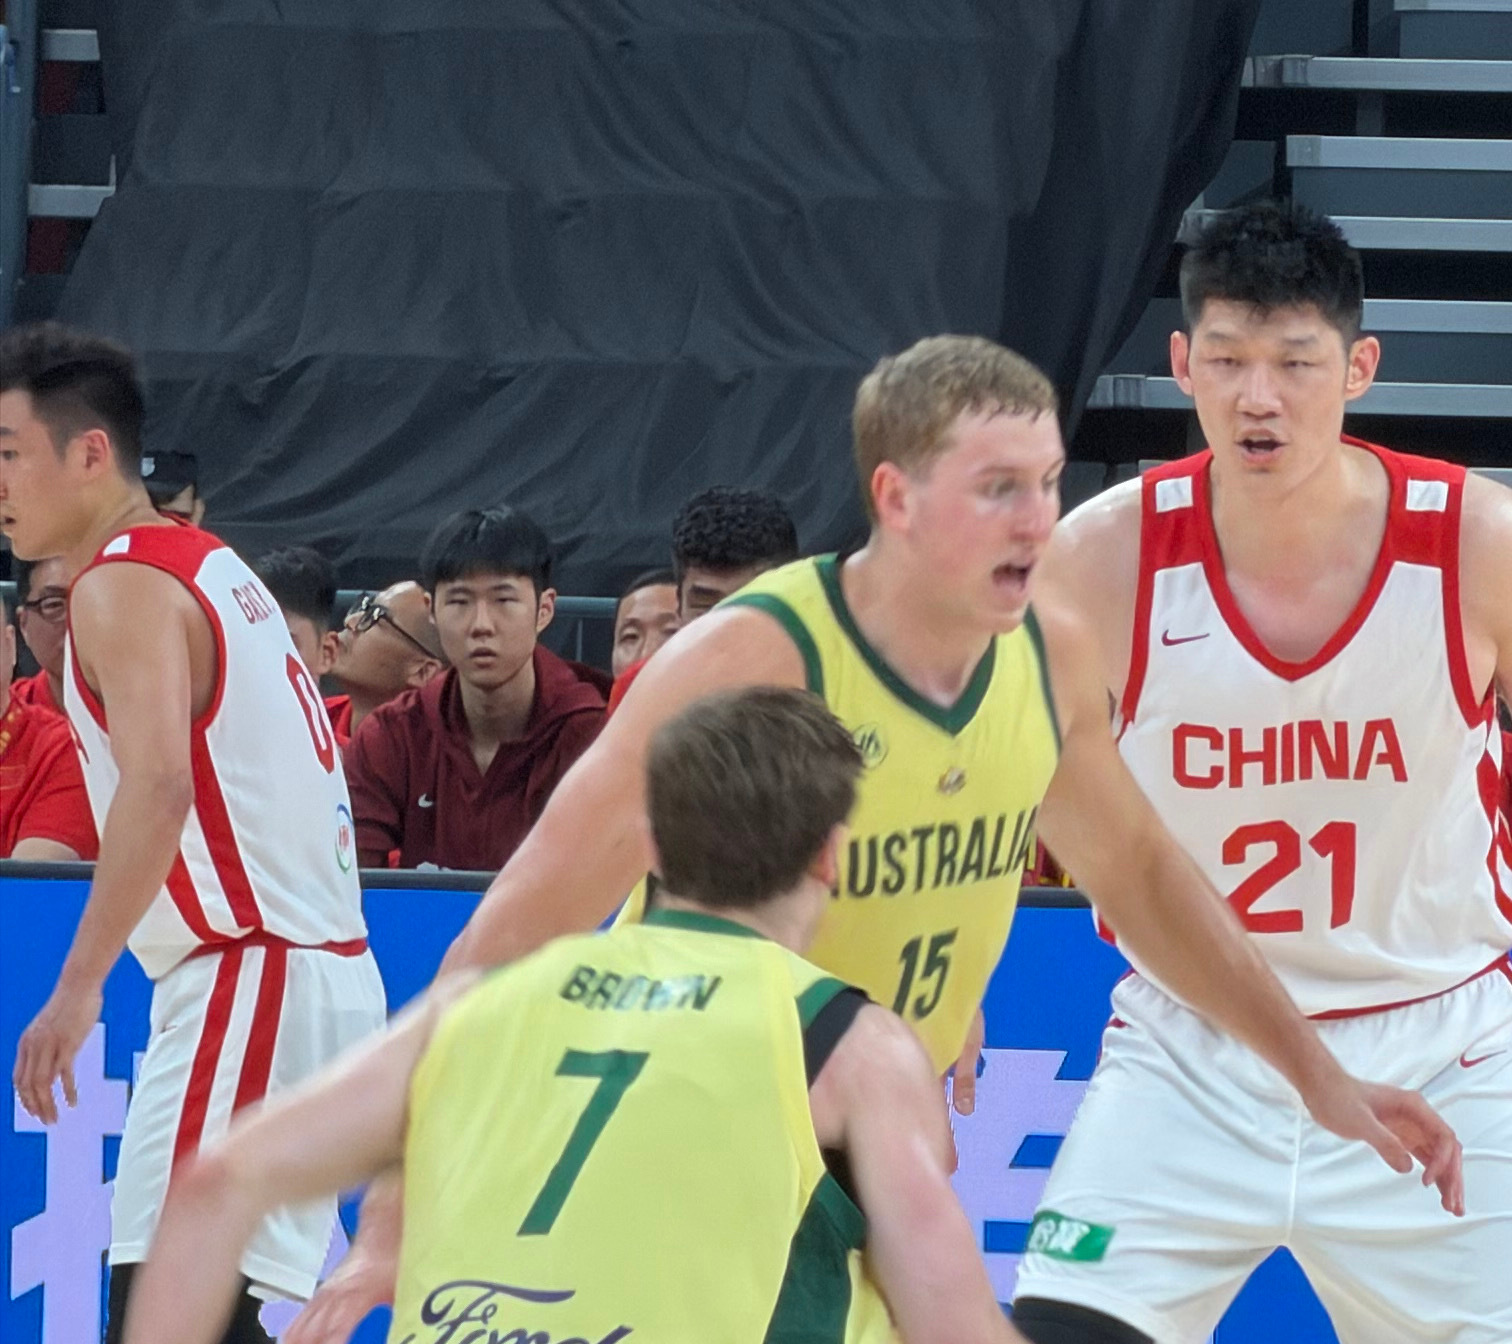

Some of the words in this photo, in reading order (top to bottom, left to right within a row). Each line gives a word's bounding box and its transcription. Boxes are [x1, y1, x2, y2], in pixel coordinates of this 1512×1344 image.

[1172, 717, 1409, 790] CHINA
[830, 805, 1039, 899] USTRALIA
[1222, 819, 1356, 934] 21
[560, 965, 723, 1013] BROWN
[895, 929, 957, 1020] 15
[516, 1047, 650, 1237] 7
